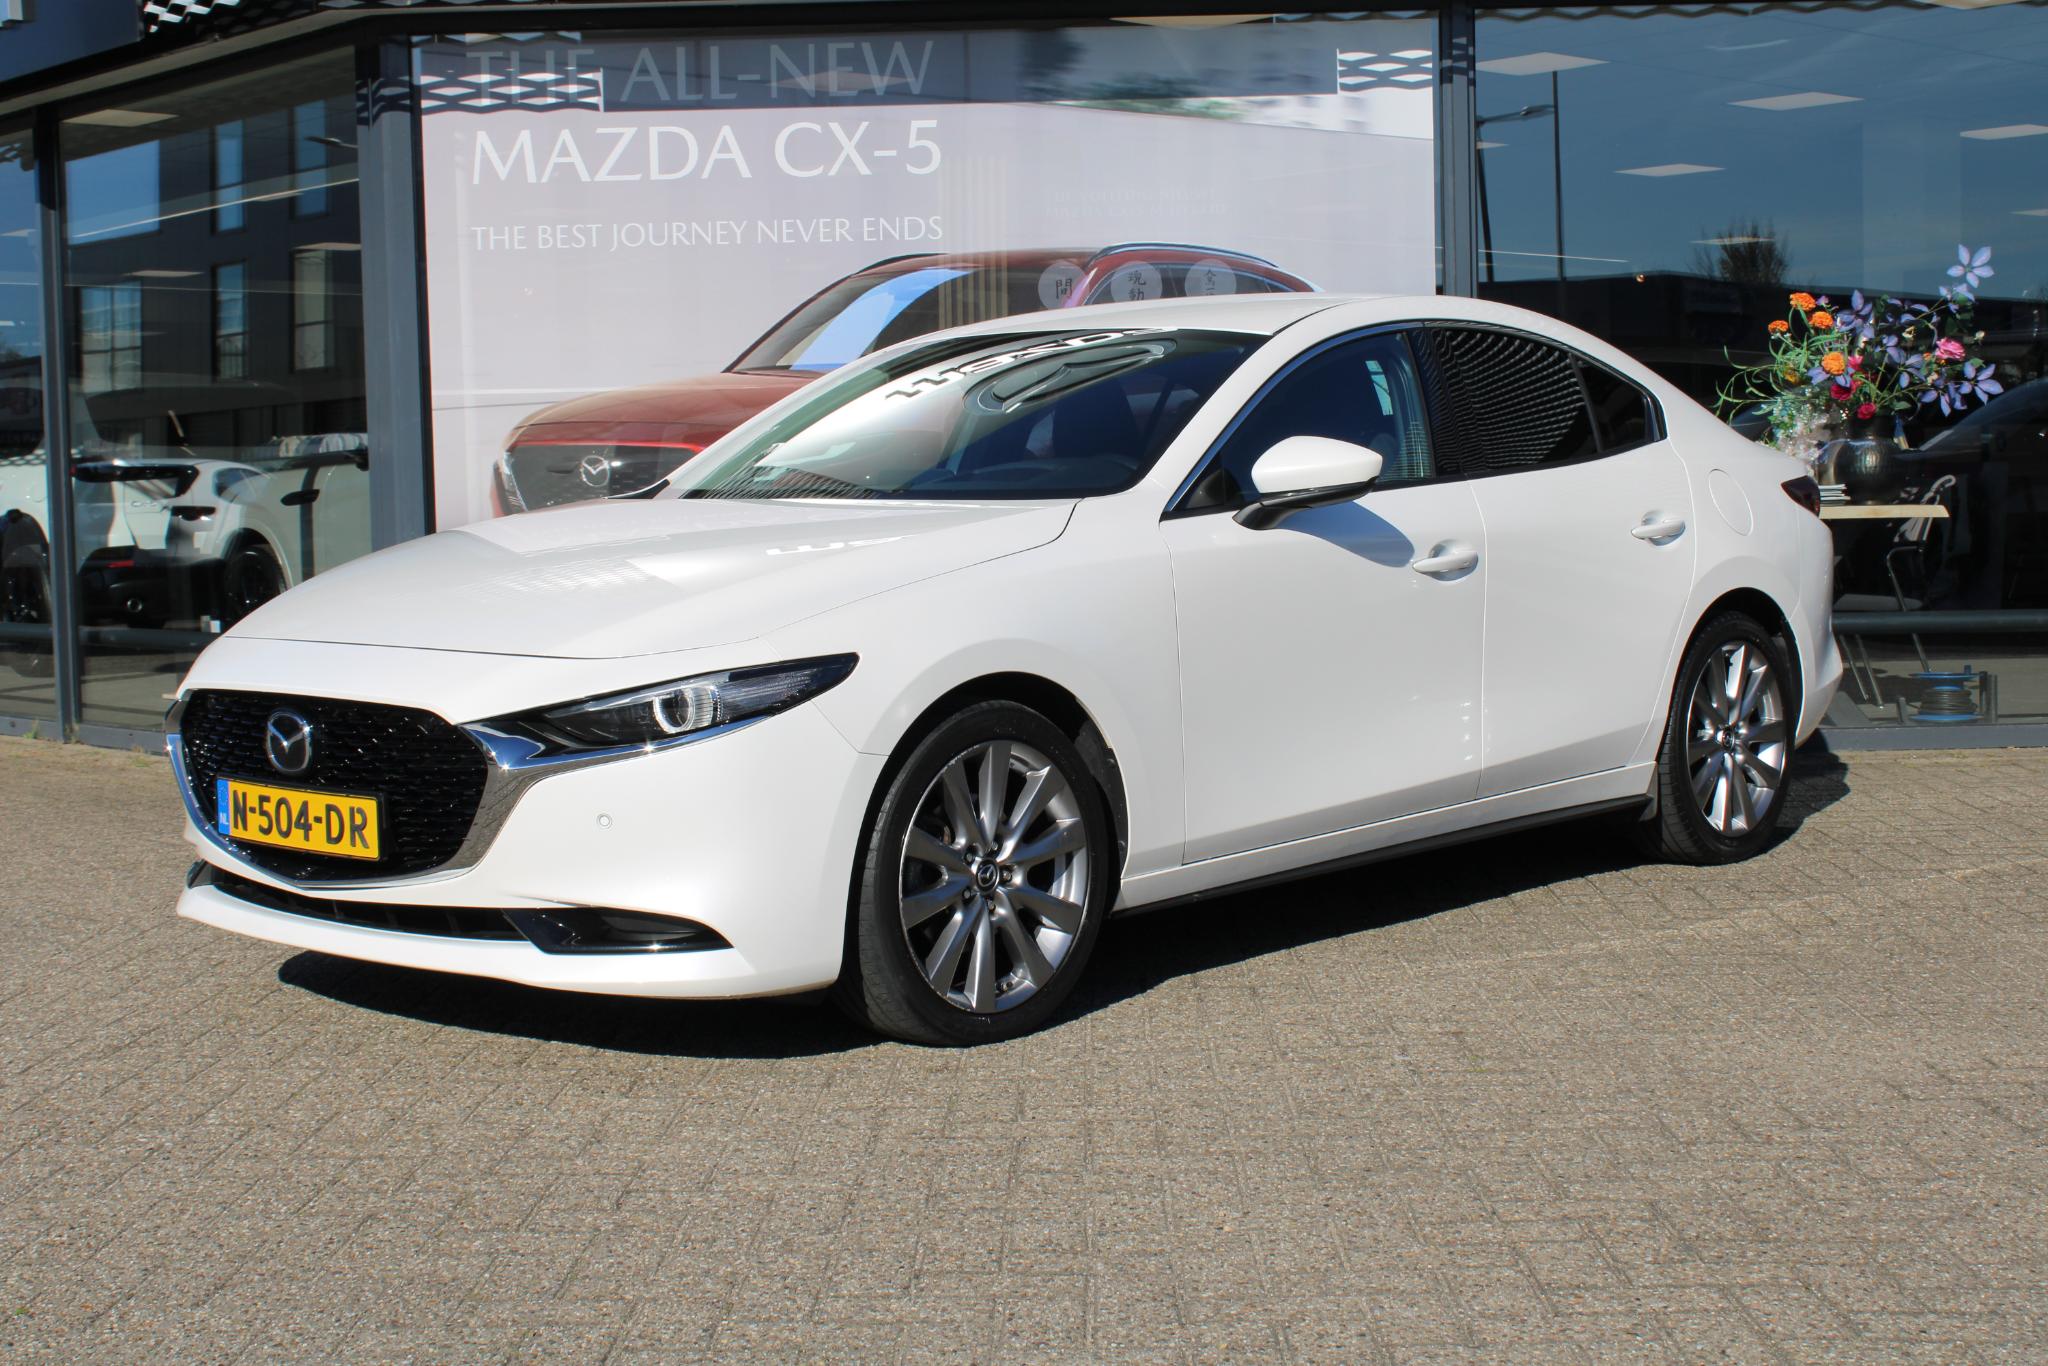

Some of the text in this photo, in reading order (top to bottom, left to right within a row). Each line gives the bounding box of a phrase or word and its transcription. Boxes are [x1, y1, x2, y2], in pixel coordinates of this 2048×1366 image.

[466, 40, 934, 105] THE ALL-NEW
[471, 119, 942, 186] MAZDA CX-5
[471, 215, 944, 253] THE BEST JOURNEY NEVER ENDS
[232, 789, 370, 850] N-504-DR
